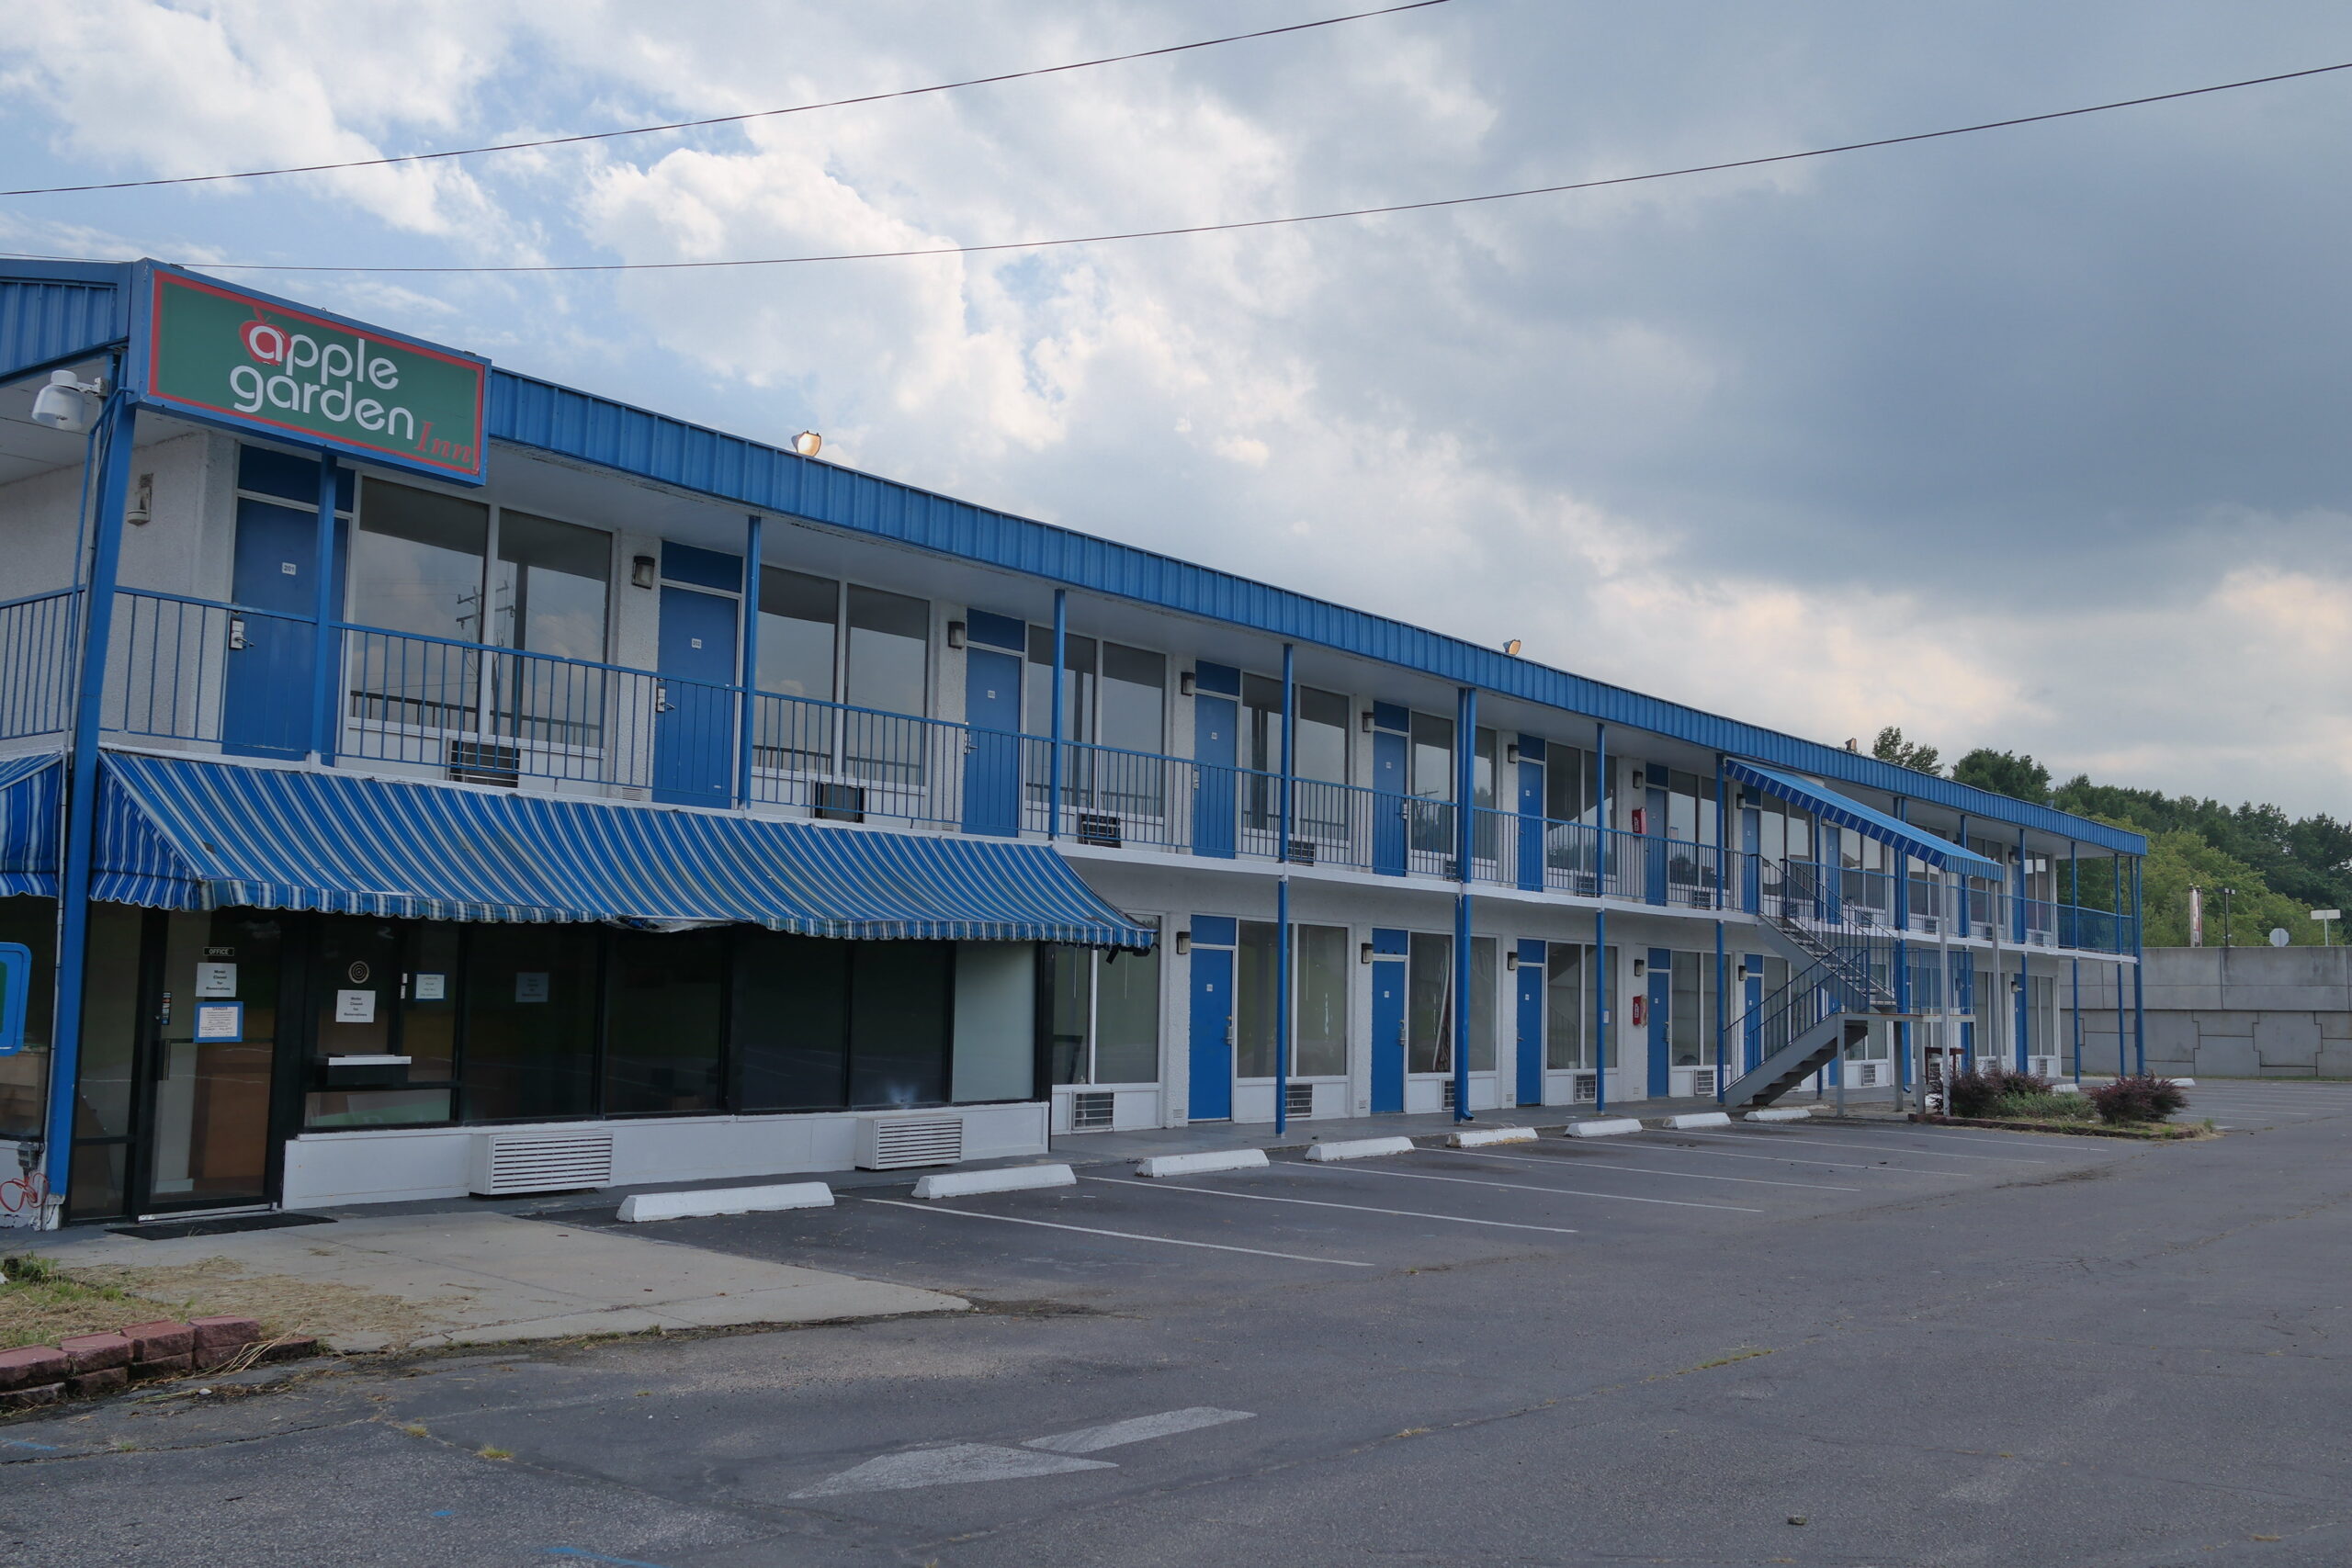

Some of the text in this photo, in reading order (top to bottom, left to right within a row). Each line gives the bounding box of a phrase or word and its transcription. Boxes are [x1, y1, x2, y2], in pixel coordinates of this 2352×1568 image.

[249, 325, 399, 389] apple
[230, 366, 473, 463] garden Inn
